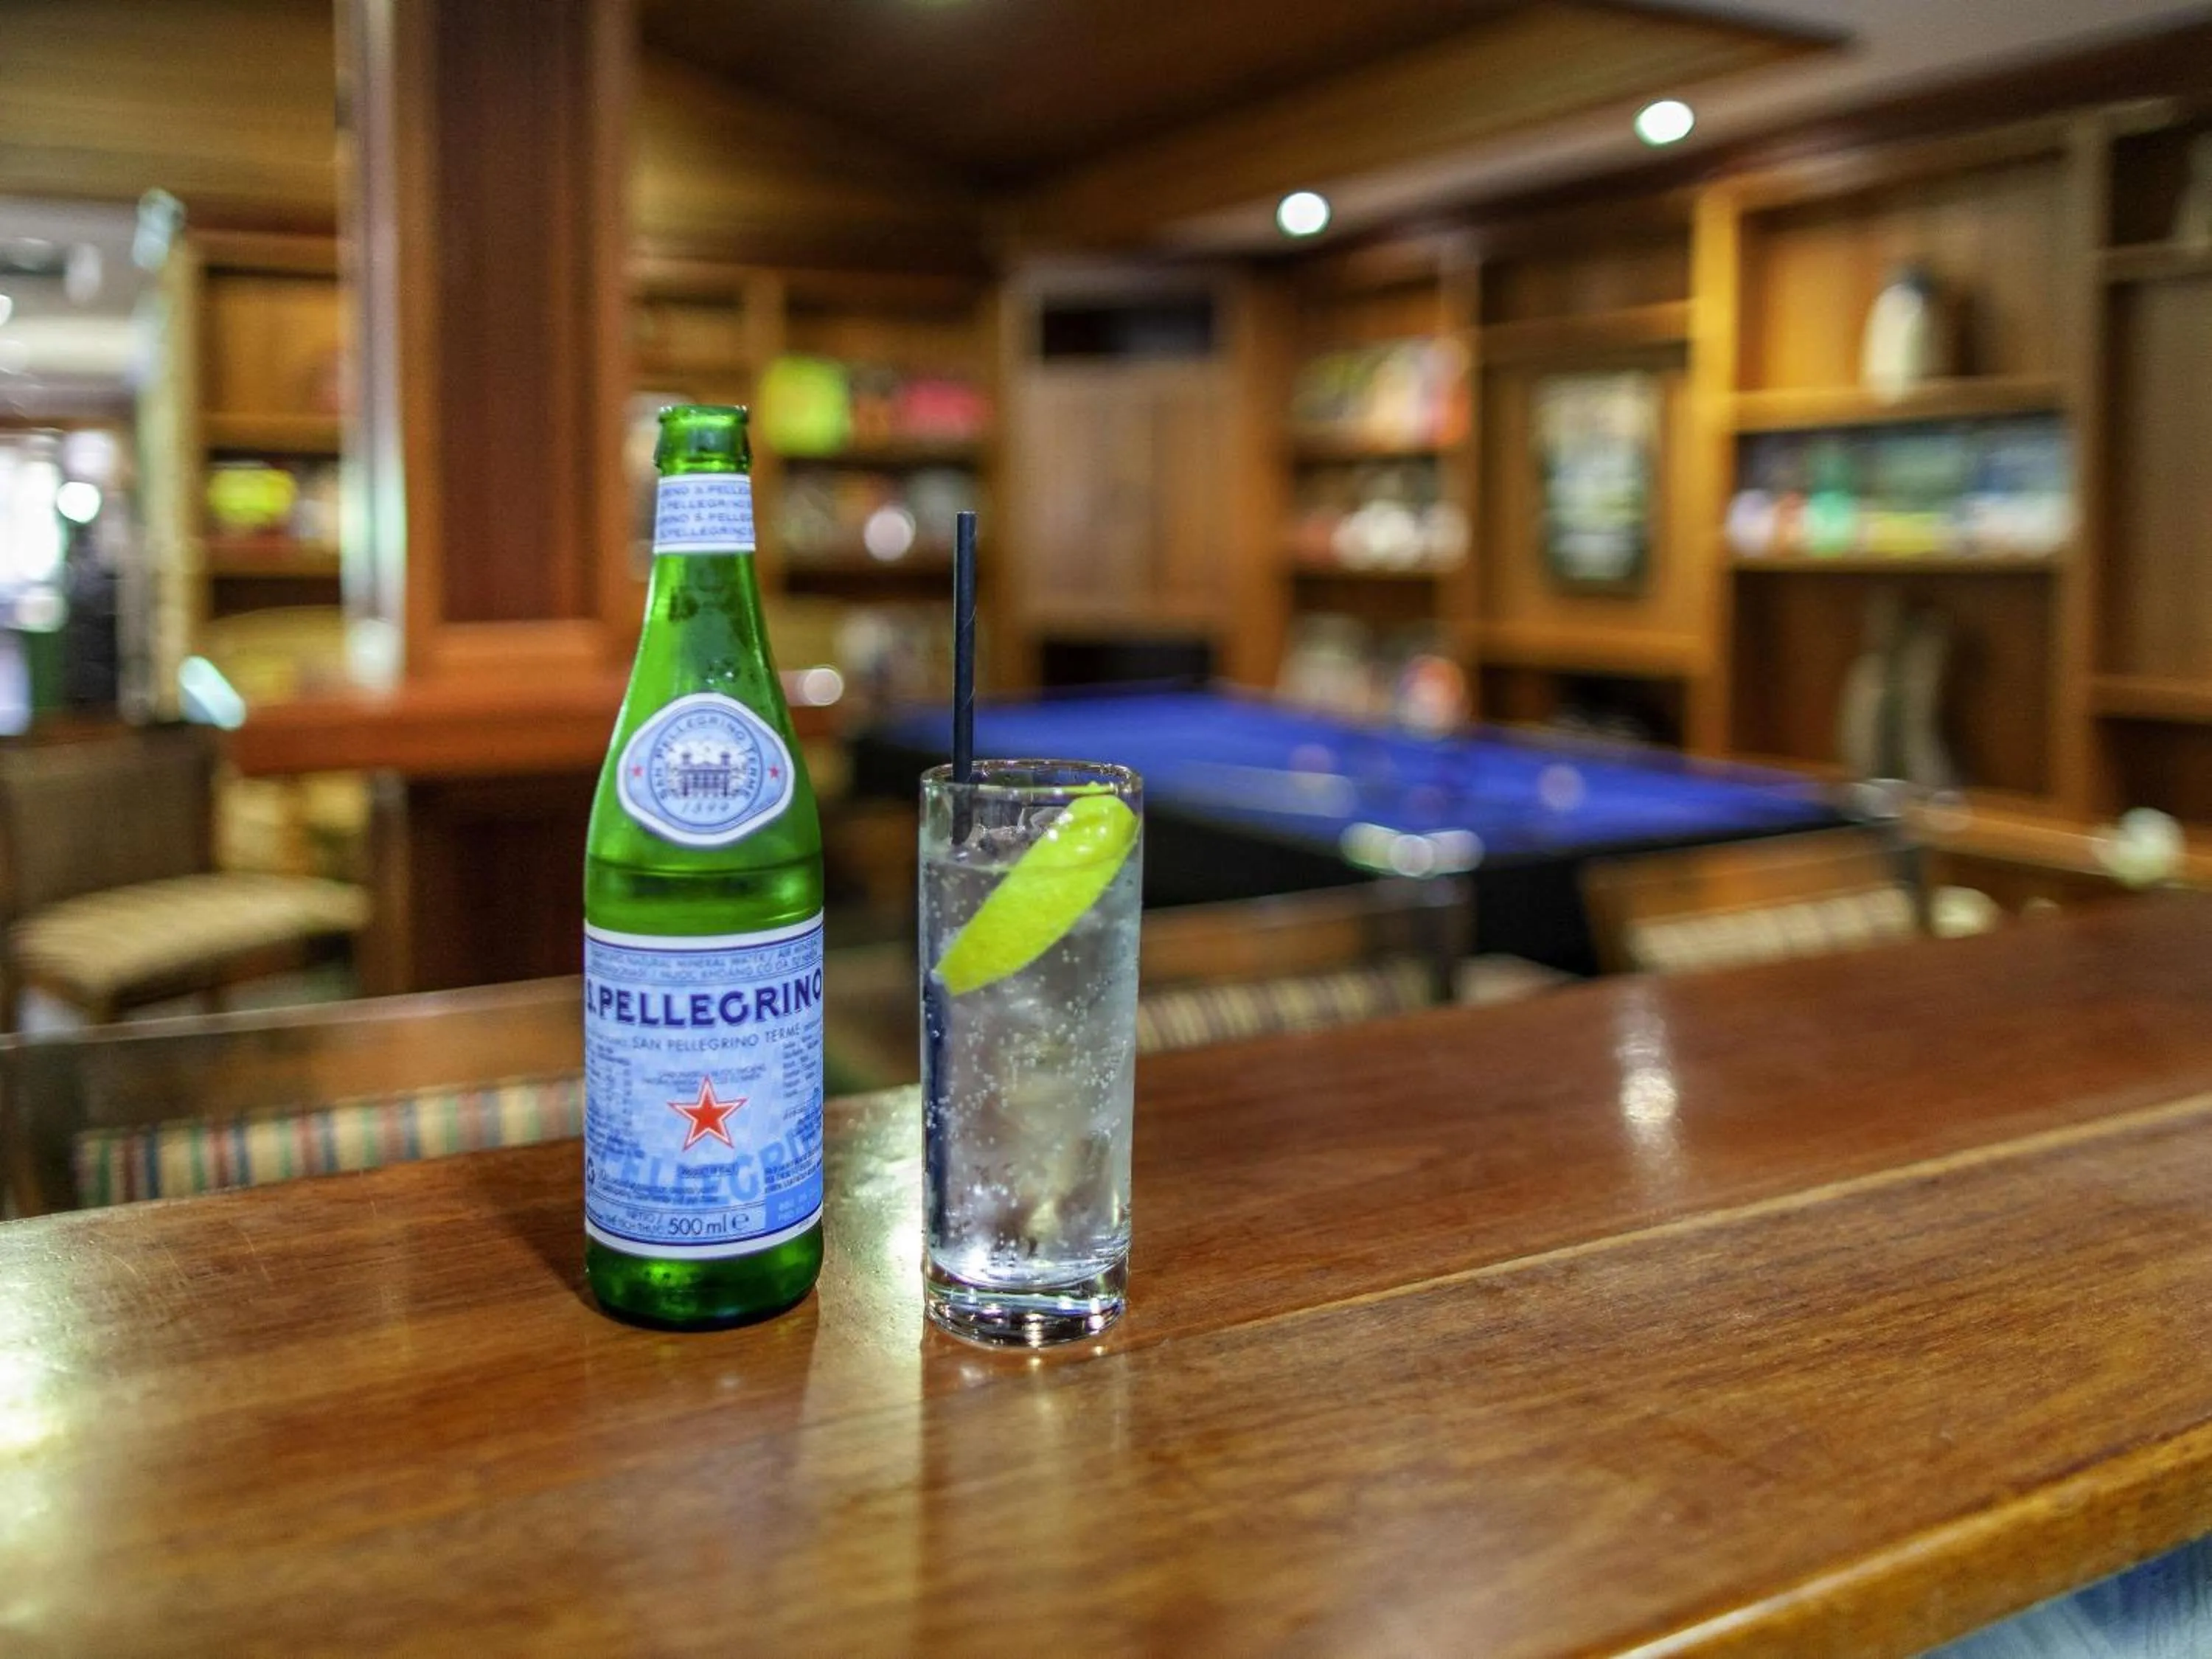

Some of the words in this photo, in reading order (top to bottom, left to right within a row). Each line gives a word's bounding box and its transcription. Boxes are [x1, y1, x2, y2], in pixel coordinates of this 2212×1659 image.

[632, 1036, 662, 1050] SAN
[667, 1034, 759, 1052] PELLEGRINO
[765, 1023, 801, 1043] TERME
[667, 1217, 703, 1236] 500
[706, 1214, 727, 1234] ml
